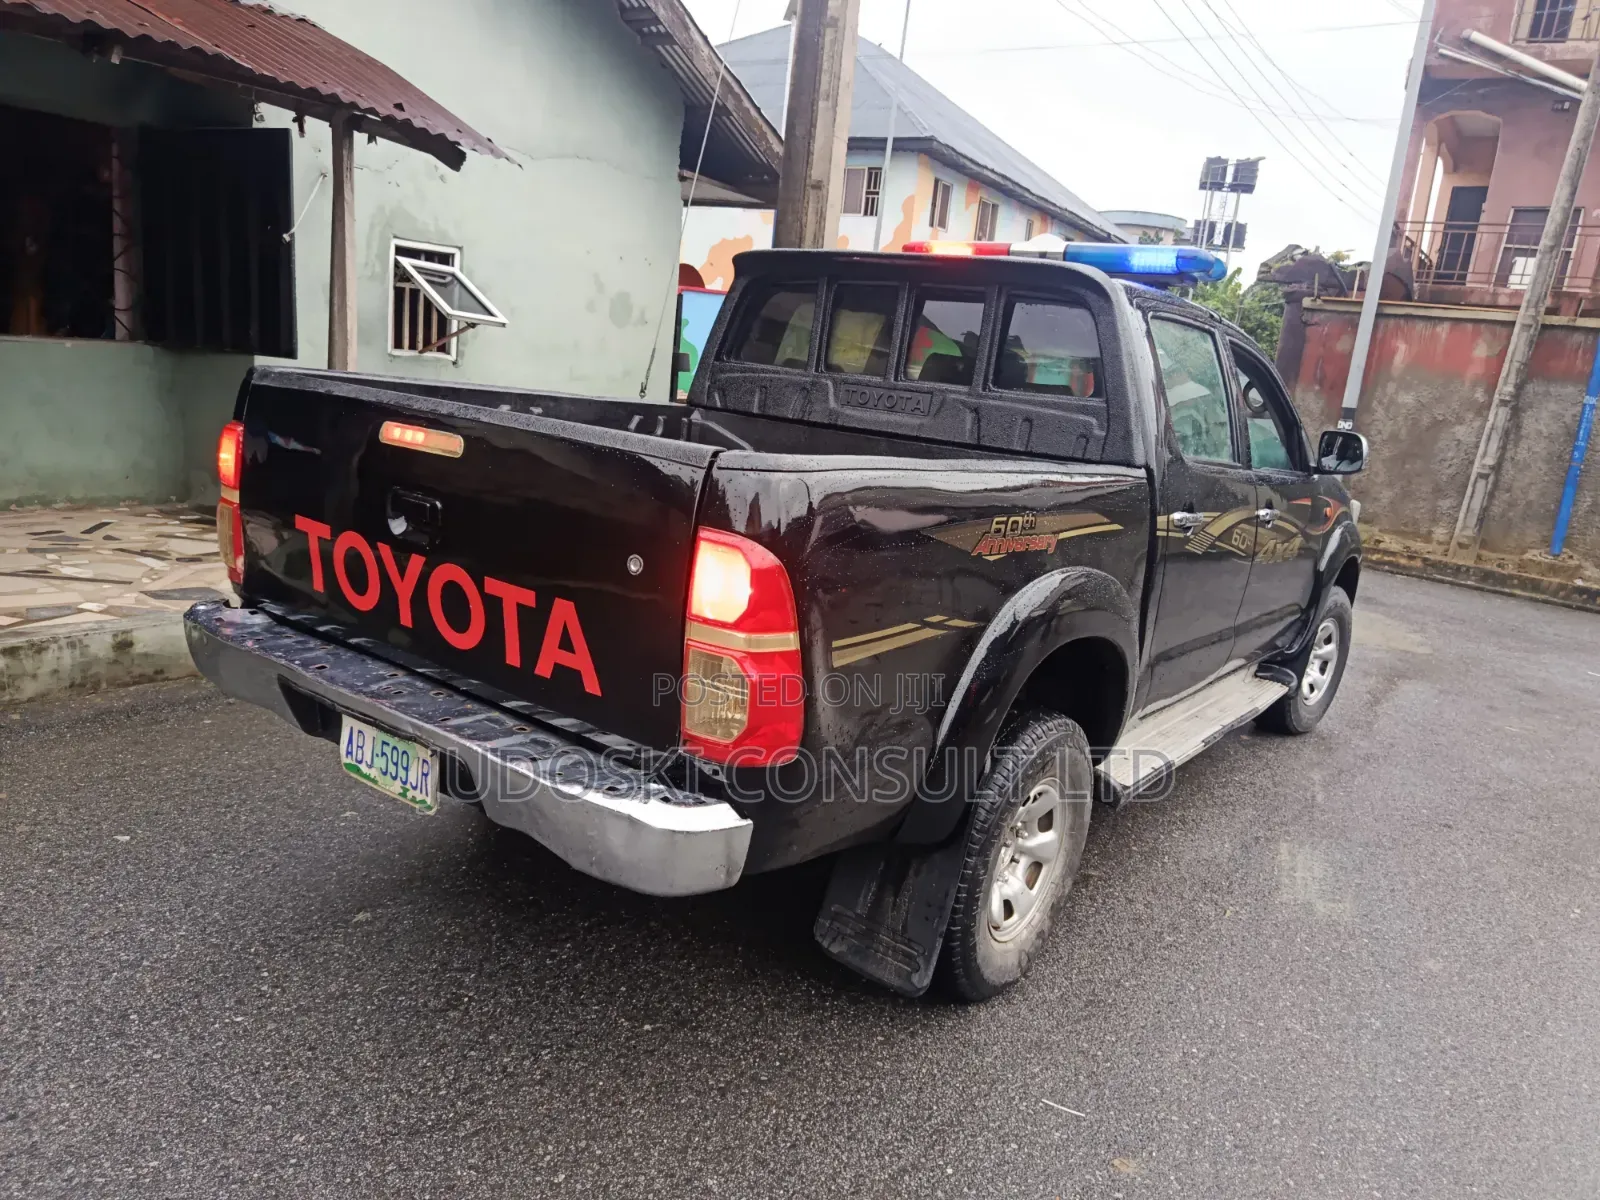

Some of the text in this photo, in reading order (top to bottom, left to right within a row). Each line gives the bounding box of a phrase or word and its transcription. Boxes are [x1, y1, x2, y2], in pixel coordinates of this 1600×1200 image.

[843, 389, 926, 414] TOYOTA
[971, 533, 1059, 556] Anniversary
[295, 514, 602, 697] TOYOTA
[345, 726, 431, 798] ABJ-599JR
